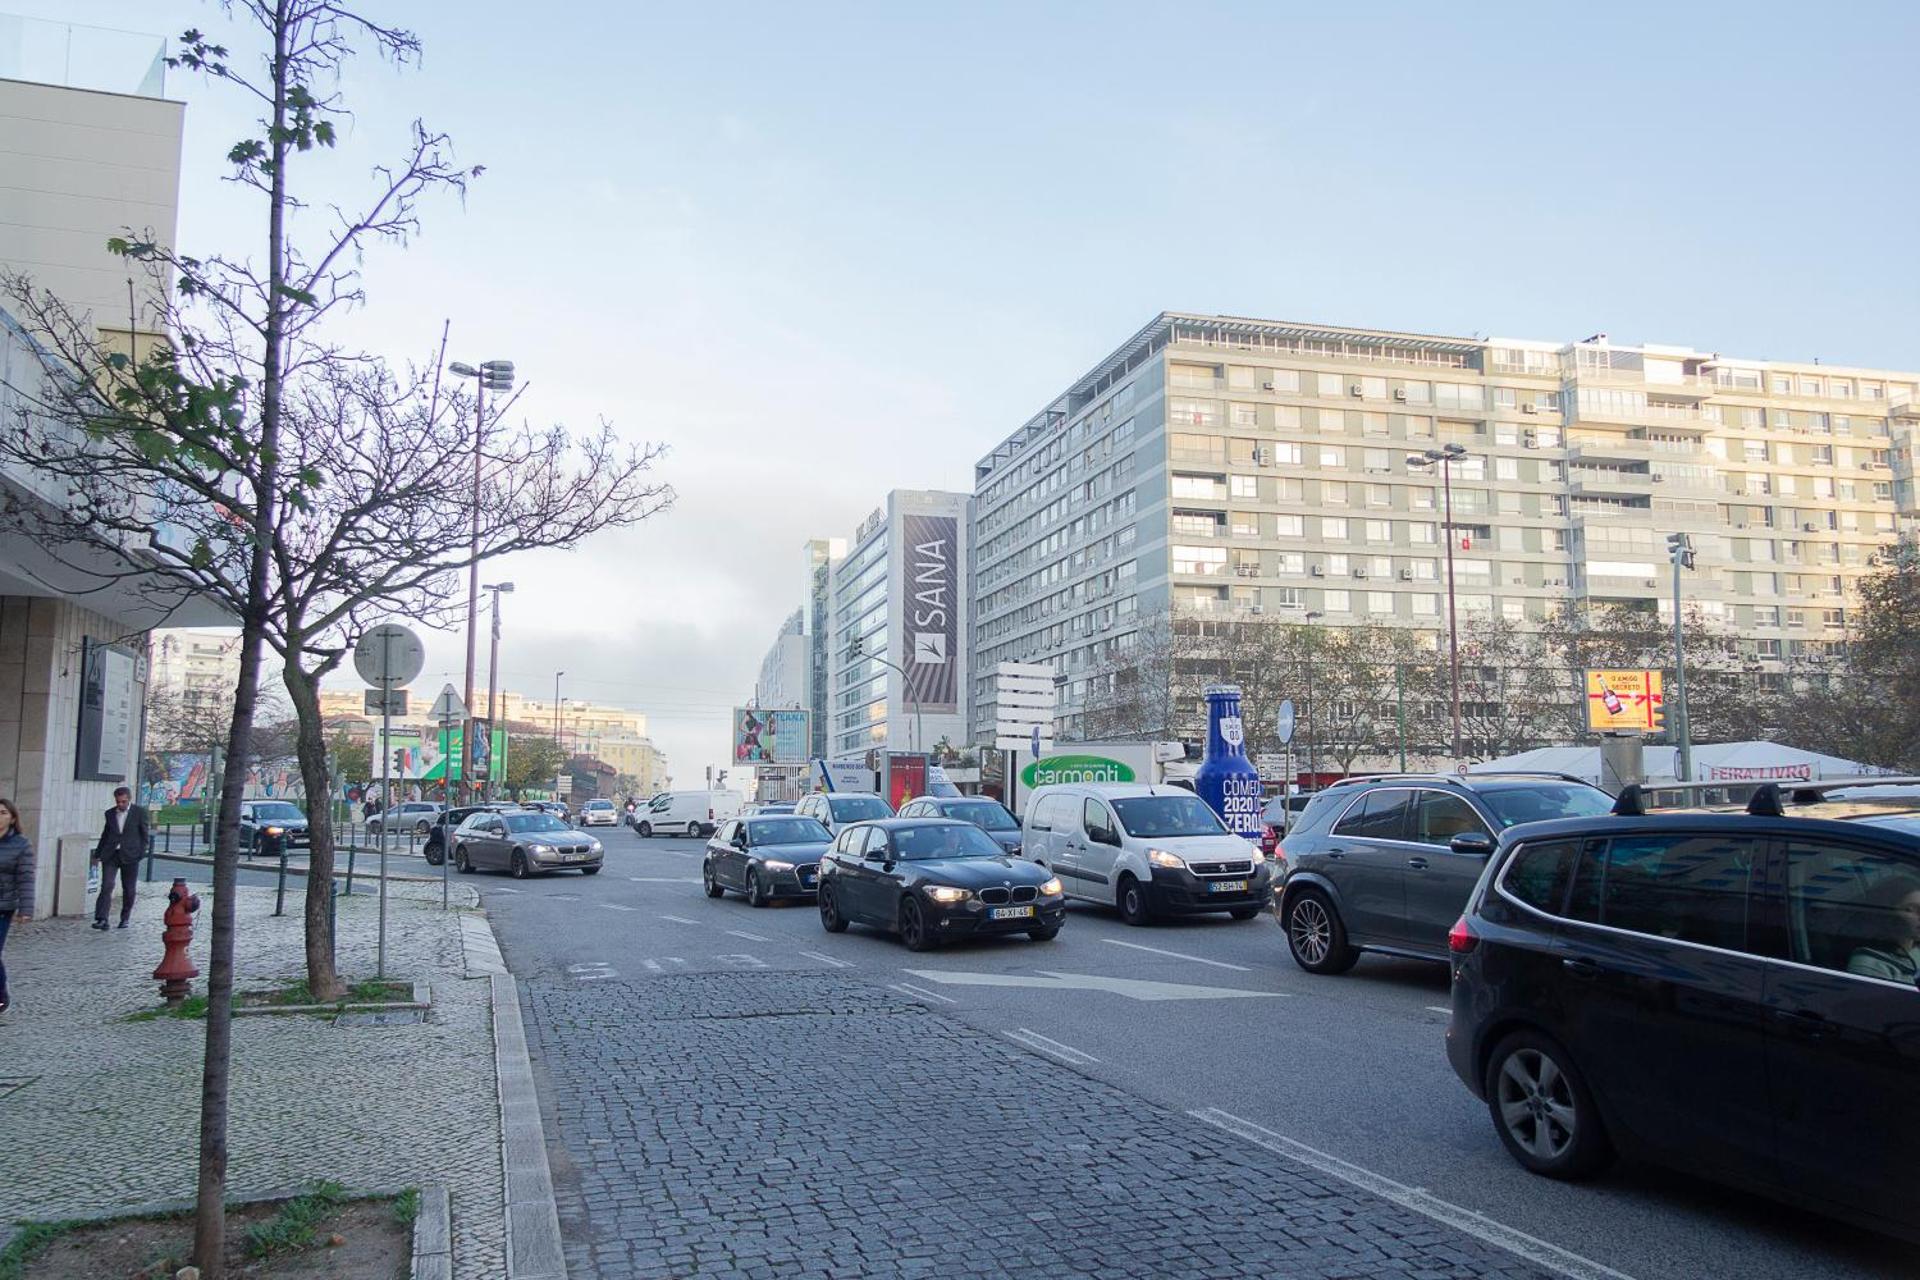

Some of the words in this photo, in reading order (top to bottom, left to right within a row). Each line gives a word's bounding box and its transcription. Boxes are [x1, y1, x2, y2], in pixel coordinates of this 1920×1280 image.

[915, 539, 946, 627] SANA
[1033, 765, 1119, 784] carmonti
[1711, 767, 1753, 780] FEIRA
[1223, 797, 1253, 812] 2020
